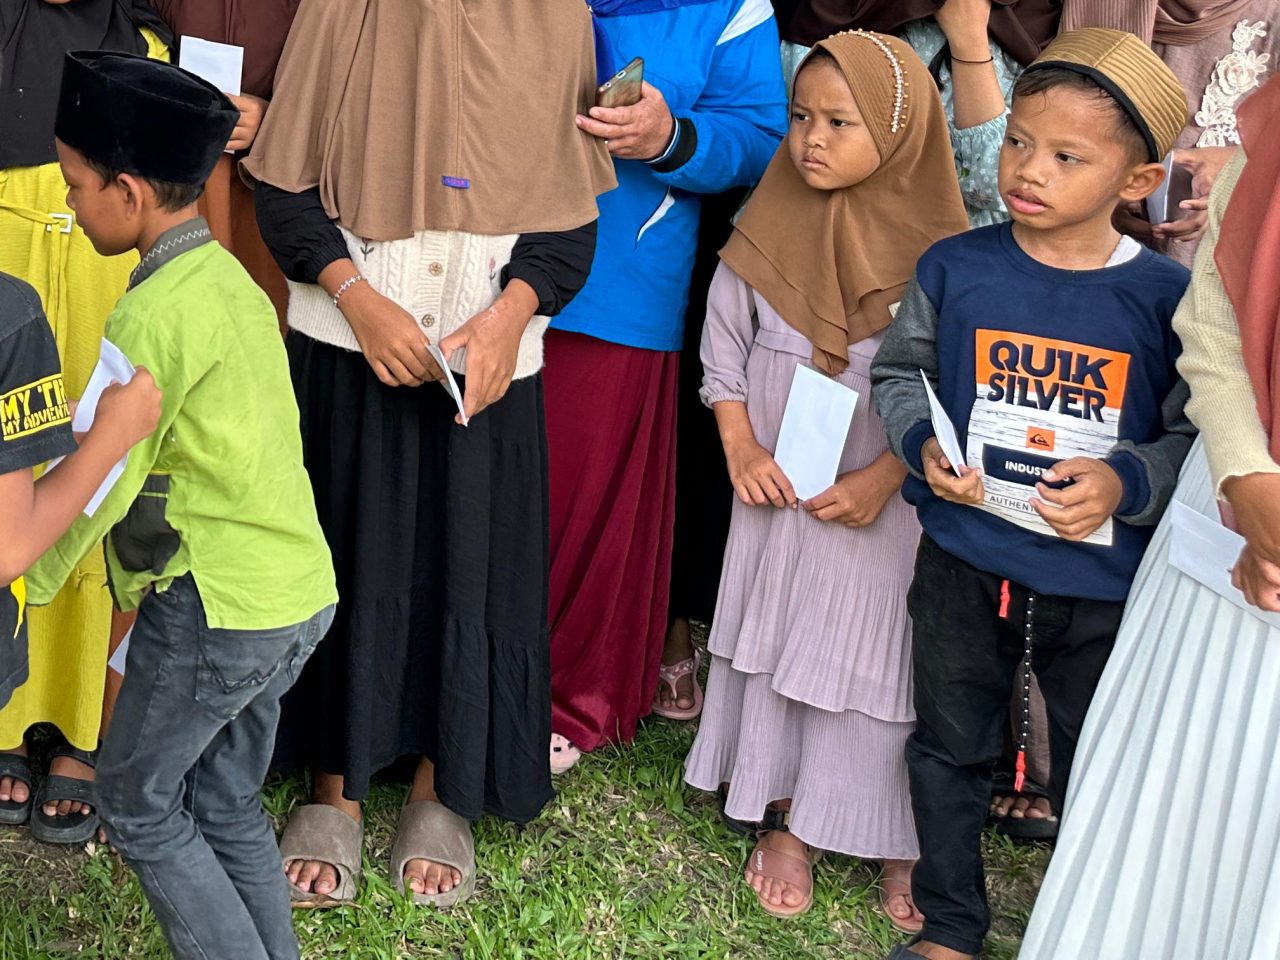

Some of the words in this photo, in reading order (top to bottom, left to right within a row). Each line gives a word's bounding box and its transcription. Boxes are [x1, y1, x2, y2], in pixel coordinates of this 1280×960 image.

[989, 340, 1114, 390] QUIK
[0, 389, 31, 423] MY
[987, 372, 1107, 423] SILVER
[1, 417, 20, 436] MY
